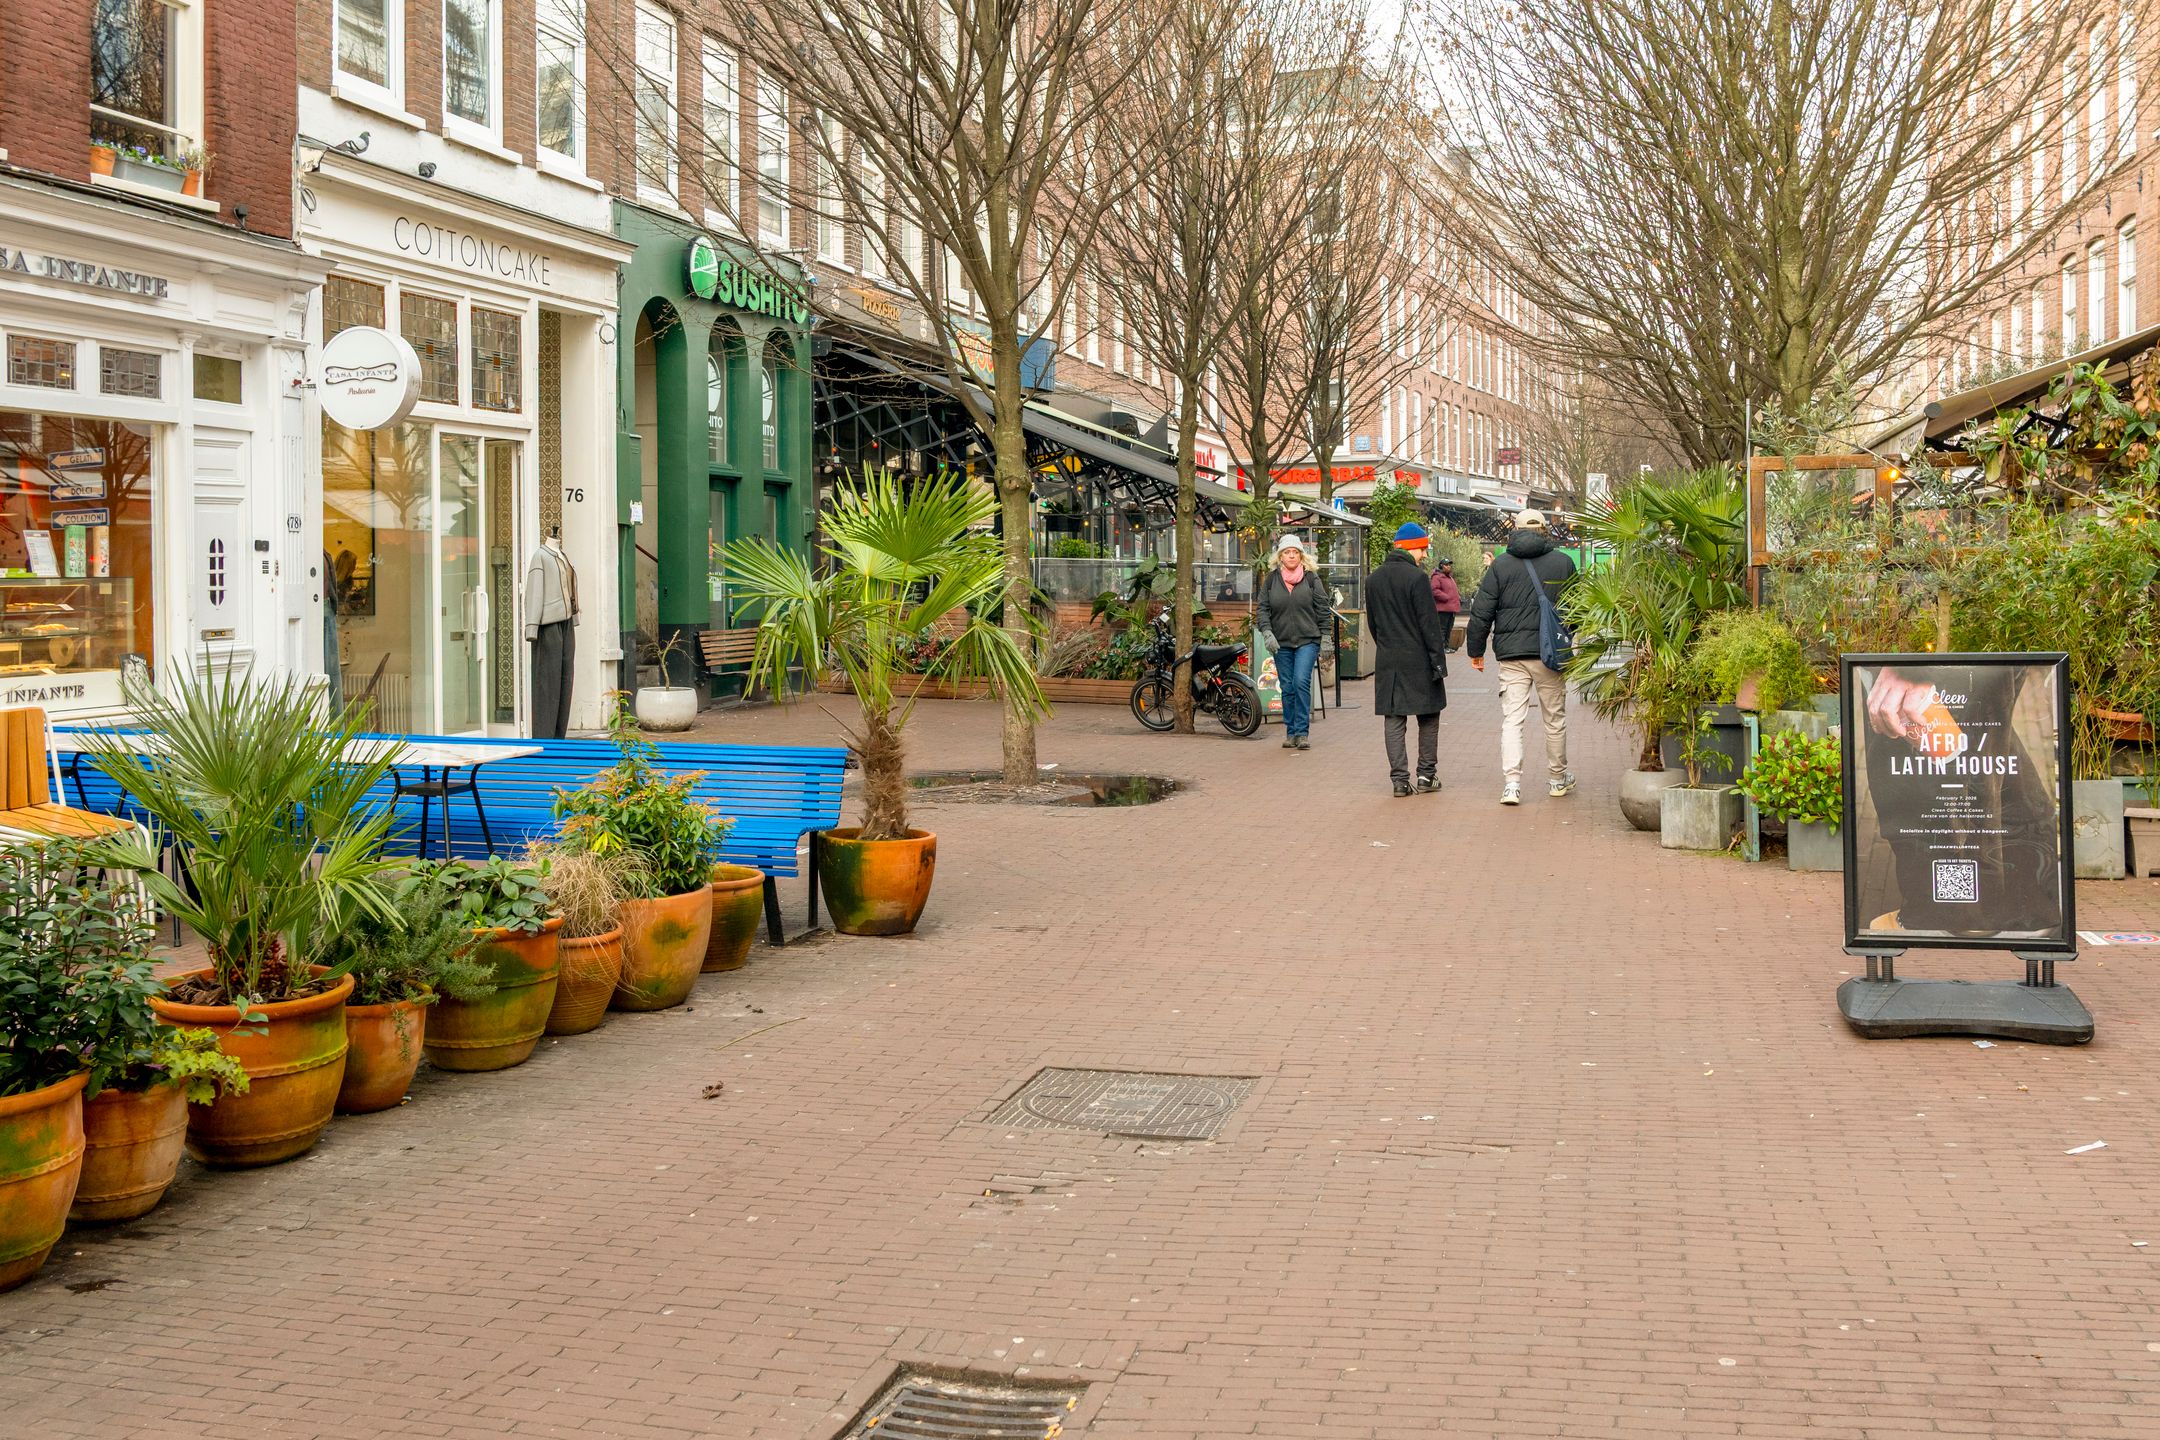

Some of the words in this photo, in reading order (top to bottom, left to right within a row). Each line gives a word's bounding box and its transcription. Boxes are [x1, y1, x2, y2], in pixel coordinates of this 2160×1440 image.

[394, 216, 550, 286] COTTONCAKE
[42, 255, 168, 298] INFANTE
[719, 260, 808, 325] SUSHITO
[356, 369, 394, 377] INFANTE
[69, 454, 93, 464] GELATI
[71, 486, 93, 496] DOLCI
[565, 488, 584, 502] 76
[65, 514, 104, 524] COLAZIONI
[290, 516, 299, 529] 78
[5, 684, 84, 704] INFANTE
[1931, 689, 1968, 705] Cleen
[1919, 733, 1968, 752] AFRO
[1891, 756, 1947, 775] LATIN
[1956, 756, 2018, 775] HOUSE
